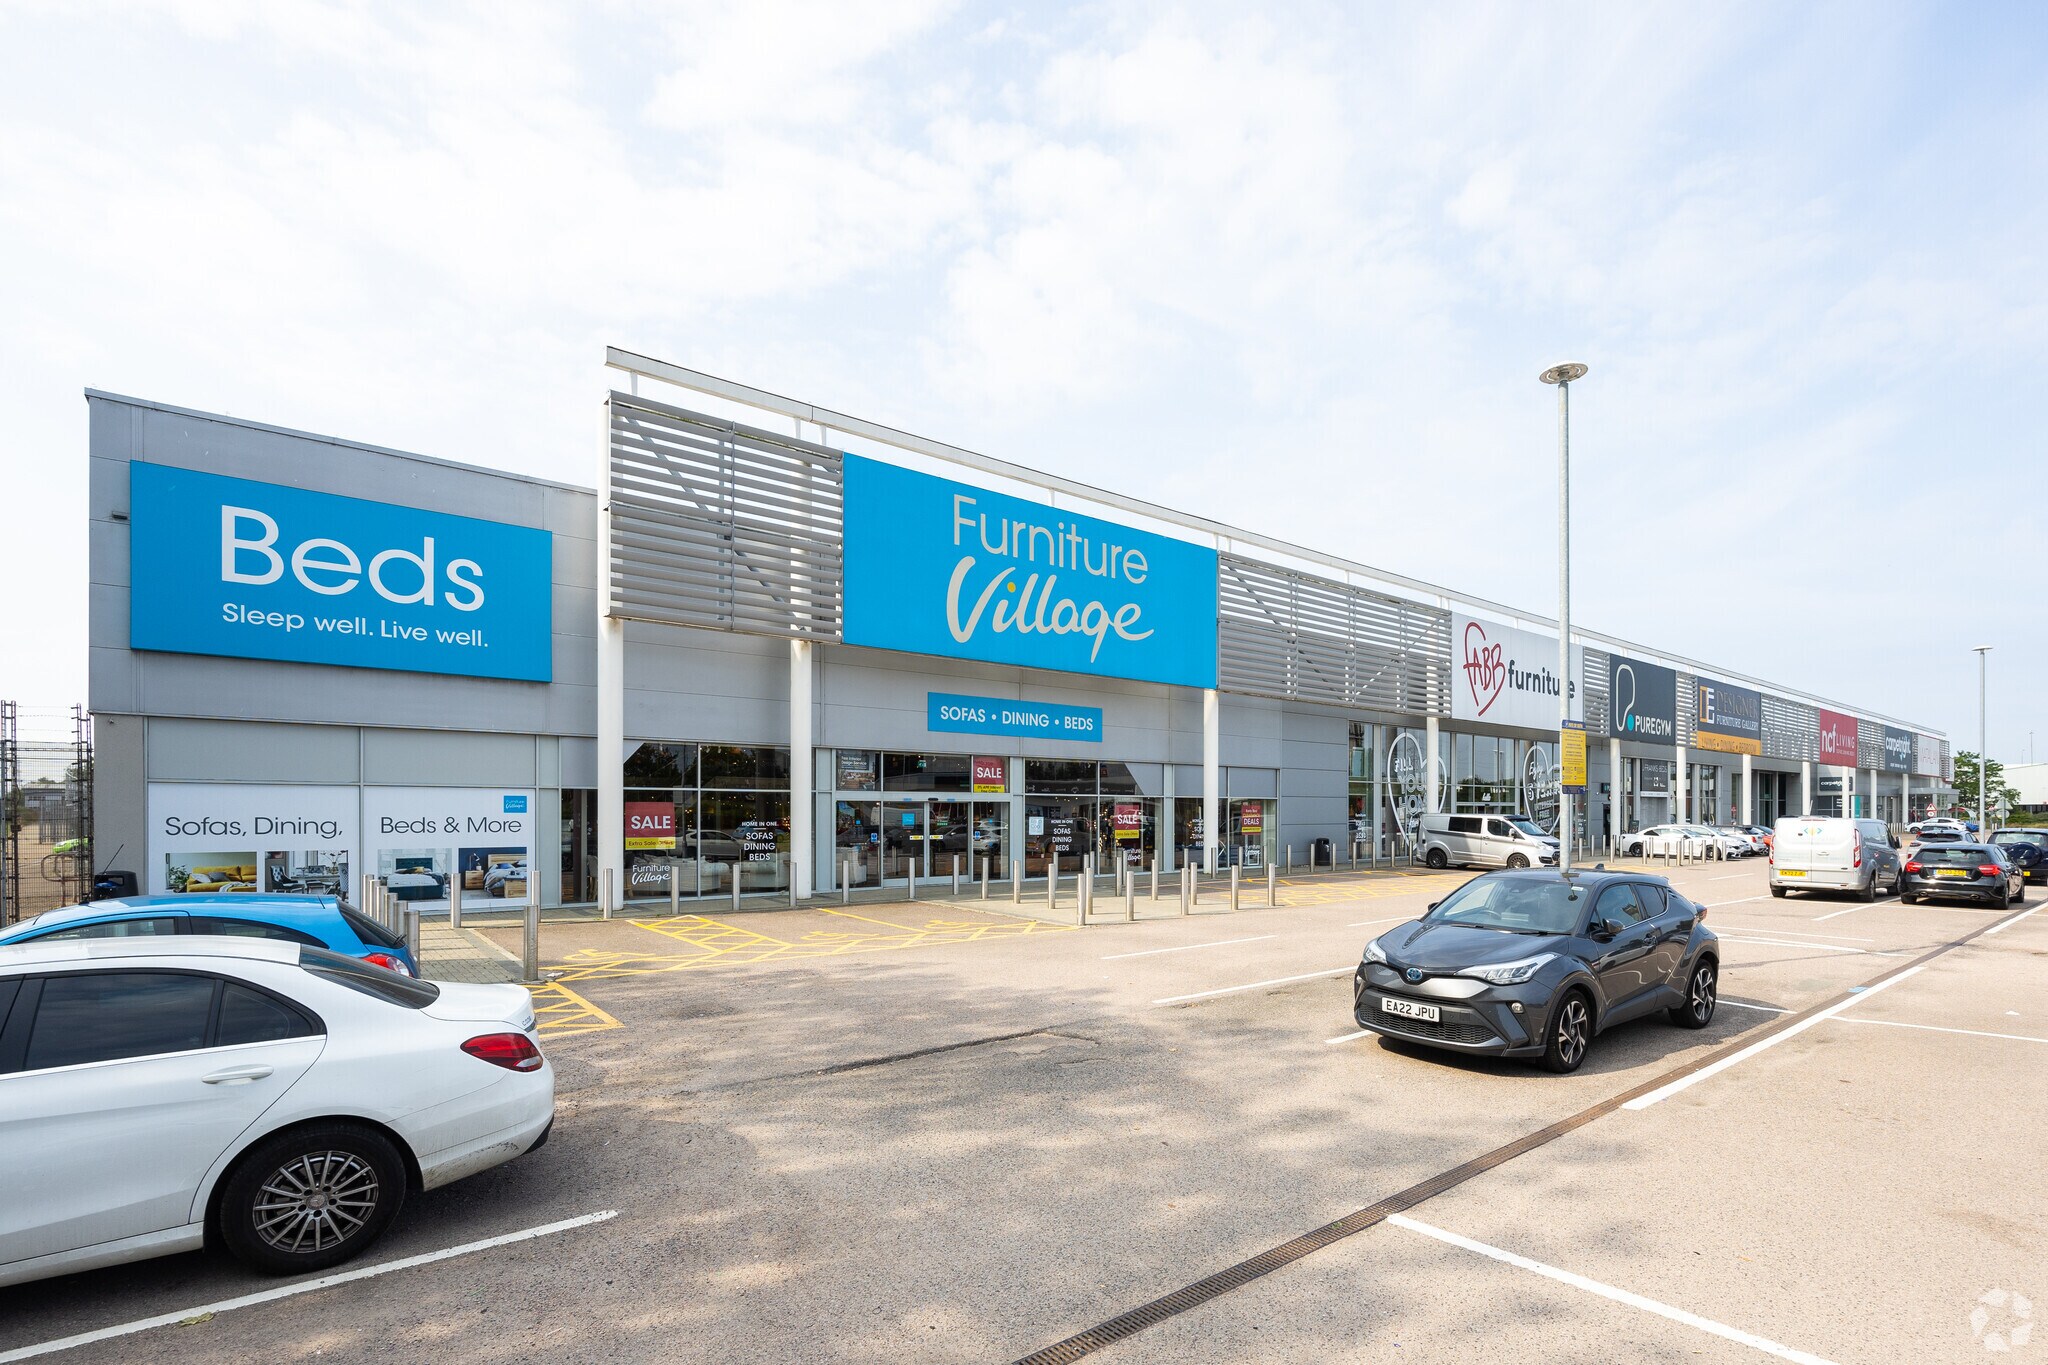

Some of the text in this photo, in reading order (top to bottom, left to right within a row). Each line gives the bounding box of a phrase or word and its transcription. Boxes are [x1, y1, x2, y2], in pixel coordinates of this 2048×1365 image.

[954, 493, 1148, 585] Furniture
[221, 504, 485, 612] Beds
[946, 555, 1155, 664] Village
[222, 602, 489, 647] Sleep well. Live well.
[1508, 659, 1576, 699] furnitue
[940, 705, 1093, 731] SOFAS DINING BEDS
[1635, 715, 1672, 737] PUREGYM
[1822, 723, 1836, 754] ncf
[977, 767, 1002, 778] SALE
[1397, 773, 1428, 794] YOU
[165, 816, 342, 839] Sofas, Dining,
[381, 816, 522, 833] Beds & More
[631, 815, 671, 829] SALE
[1117, 814, 1138, 825] SALE
[743, 842, 776, 851] DINING
[746, 832, 774, 840] SOFAS
[631, 872, 672, 886] Village
[1386, 1000, 1434, 1019] EA22 JPU
